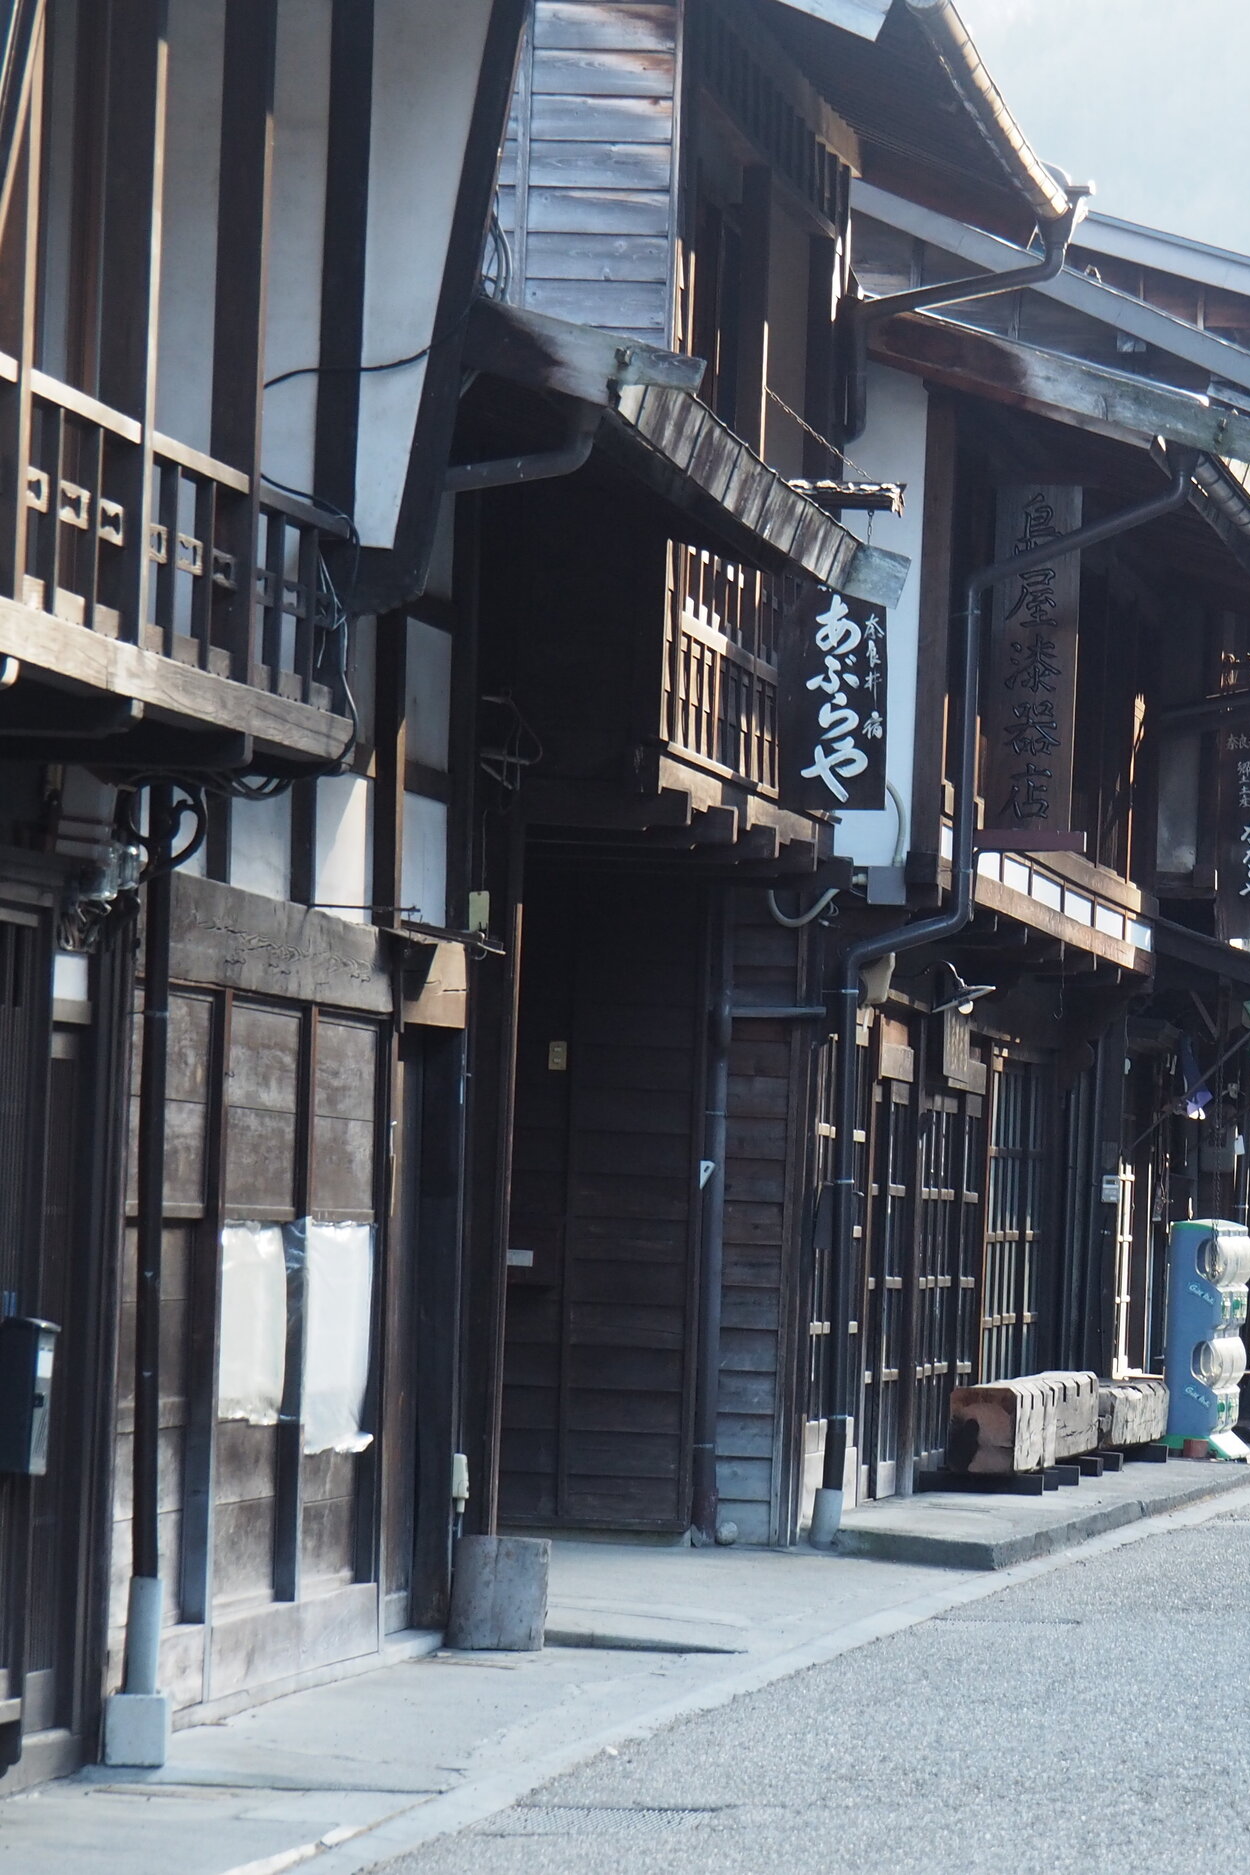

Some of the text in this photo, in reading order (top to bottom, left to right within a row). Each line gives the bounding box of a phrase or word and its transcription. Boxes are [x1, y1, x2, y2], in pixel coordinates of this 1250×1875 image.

[800, 594, 868, 804] あぶらや
[861, 613, 885, 740] 奈良井宿
